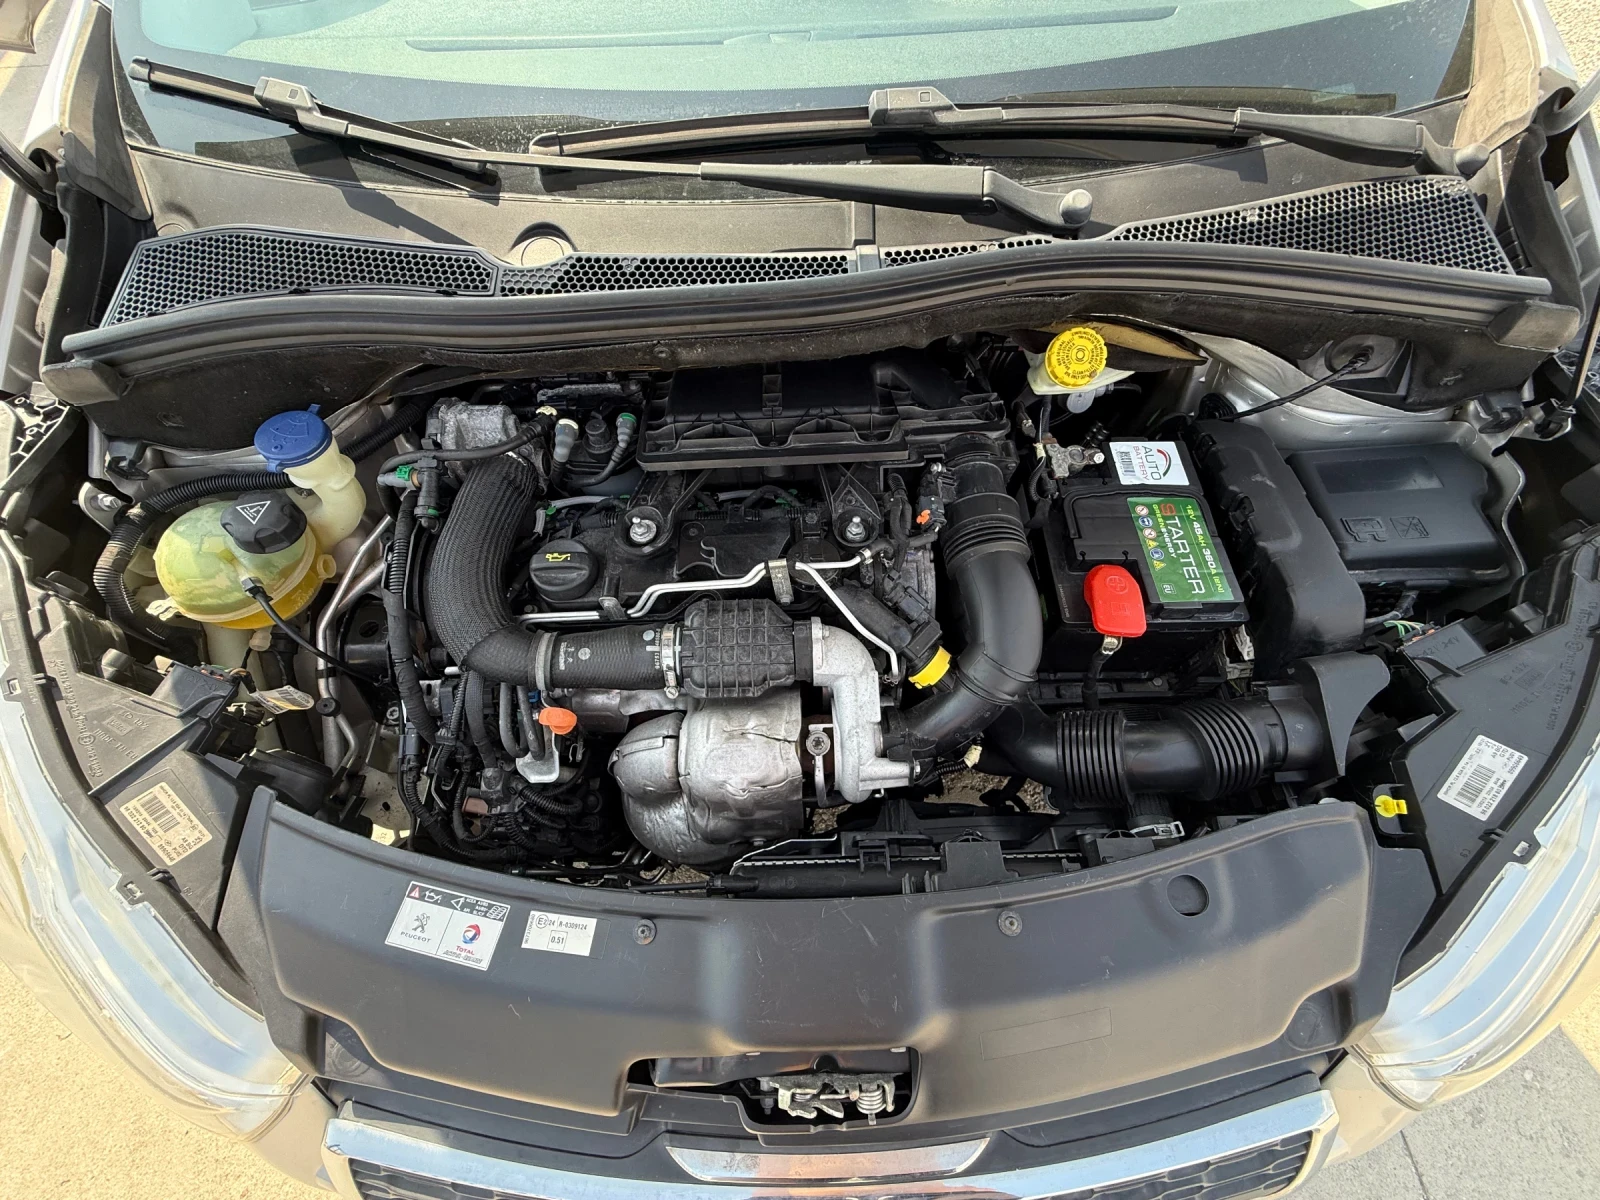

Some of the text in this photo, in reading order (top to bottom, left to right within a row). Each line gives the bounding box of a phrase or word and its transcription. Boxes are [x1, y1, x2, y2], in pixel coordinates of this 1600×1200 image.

[1133, 446, 1150, 481] BATTERY
[1142, 446, 1162, 480] AUTO
[1186, 504, 1197, 520] 12V
[1193, 521, 1207, 546] 45AH
[1160, 503, 1205, 594] STARTER
[400, 931, 431, 943] PEUGEOT
[456, 946, 474, 955] TOTAL
[551, 936, 564, 944] 0.51
